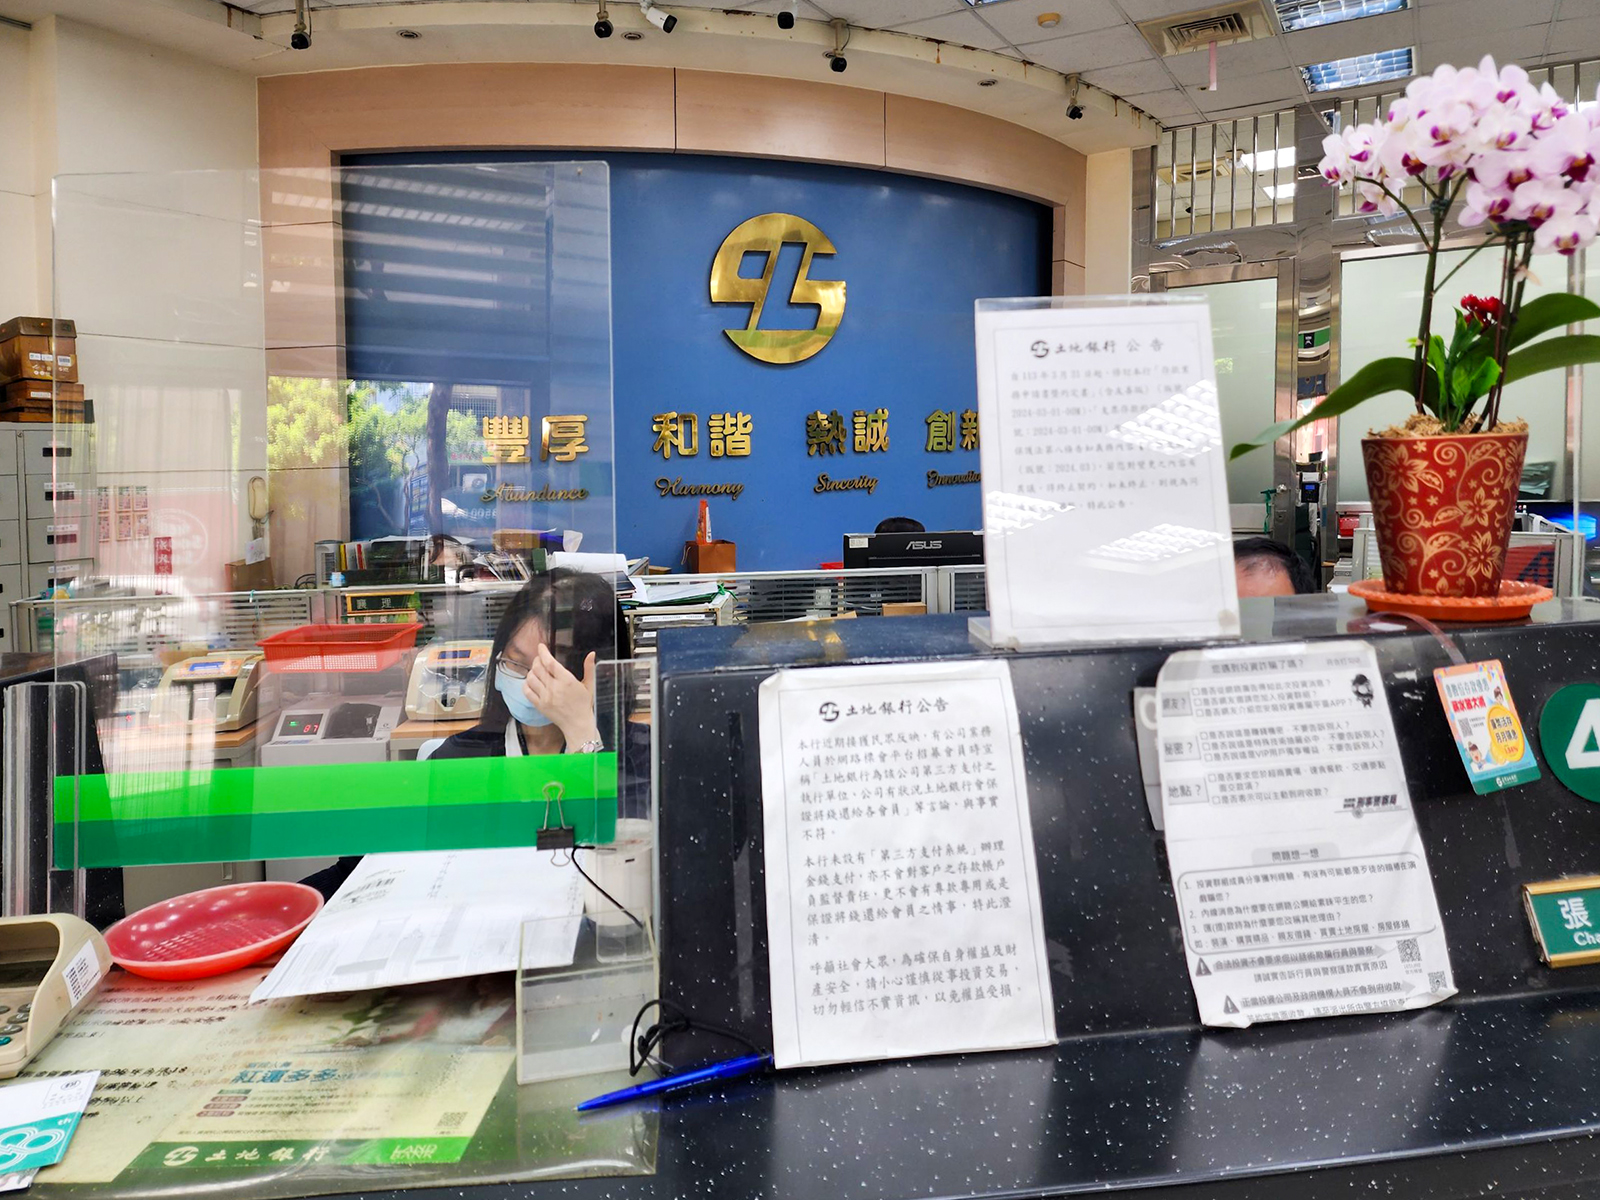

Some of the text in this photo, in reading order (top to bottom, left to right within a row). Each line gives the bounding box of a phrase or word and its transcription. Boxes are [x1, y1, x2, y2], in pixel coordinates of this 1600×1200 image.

[1055, 341, 1116, 354] 土地銀行
[482, 414, 589, 463] 豐厚
[652, 411, 753, 459] 和諧
[806, 408, 889, 456] 熱誠
[481, 480, 588, 501] Abundance
[655, 477, 744, 500] Harmony
[814, 471, 879, 495] Sincerity
[906, 540, 942, 550] ASUS
[845, 697, 949, 717] 土地銀行公告
[1168, 784, 1201, 799] 地點？
[1272, 848, 1319, 862] 問題想一想
[1557, 897, 1592, 929] 張
[205, 1147, 331, 1162] 土地銀行
